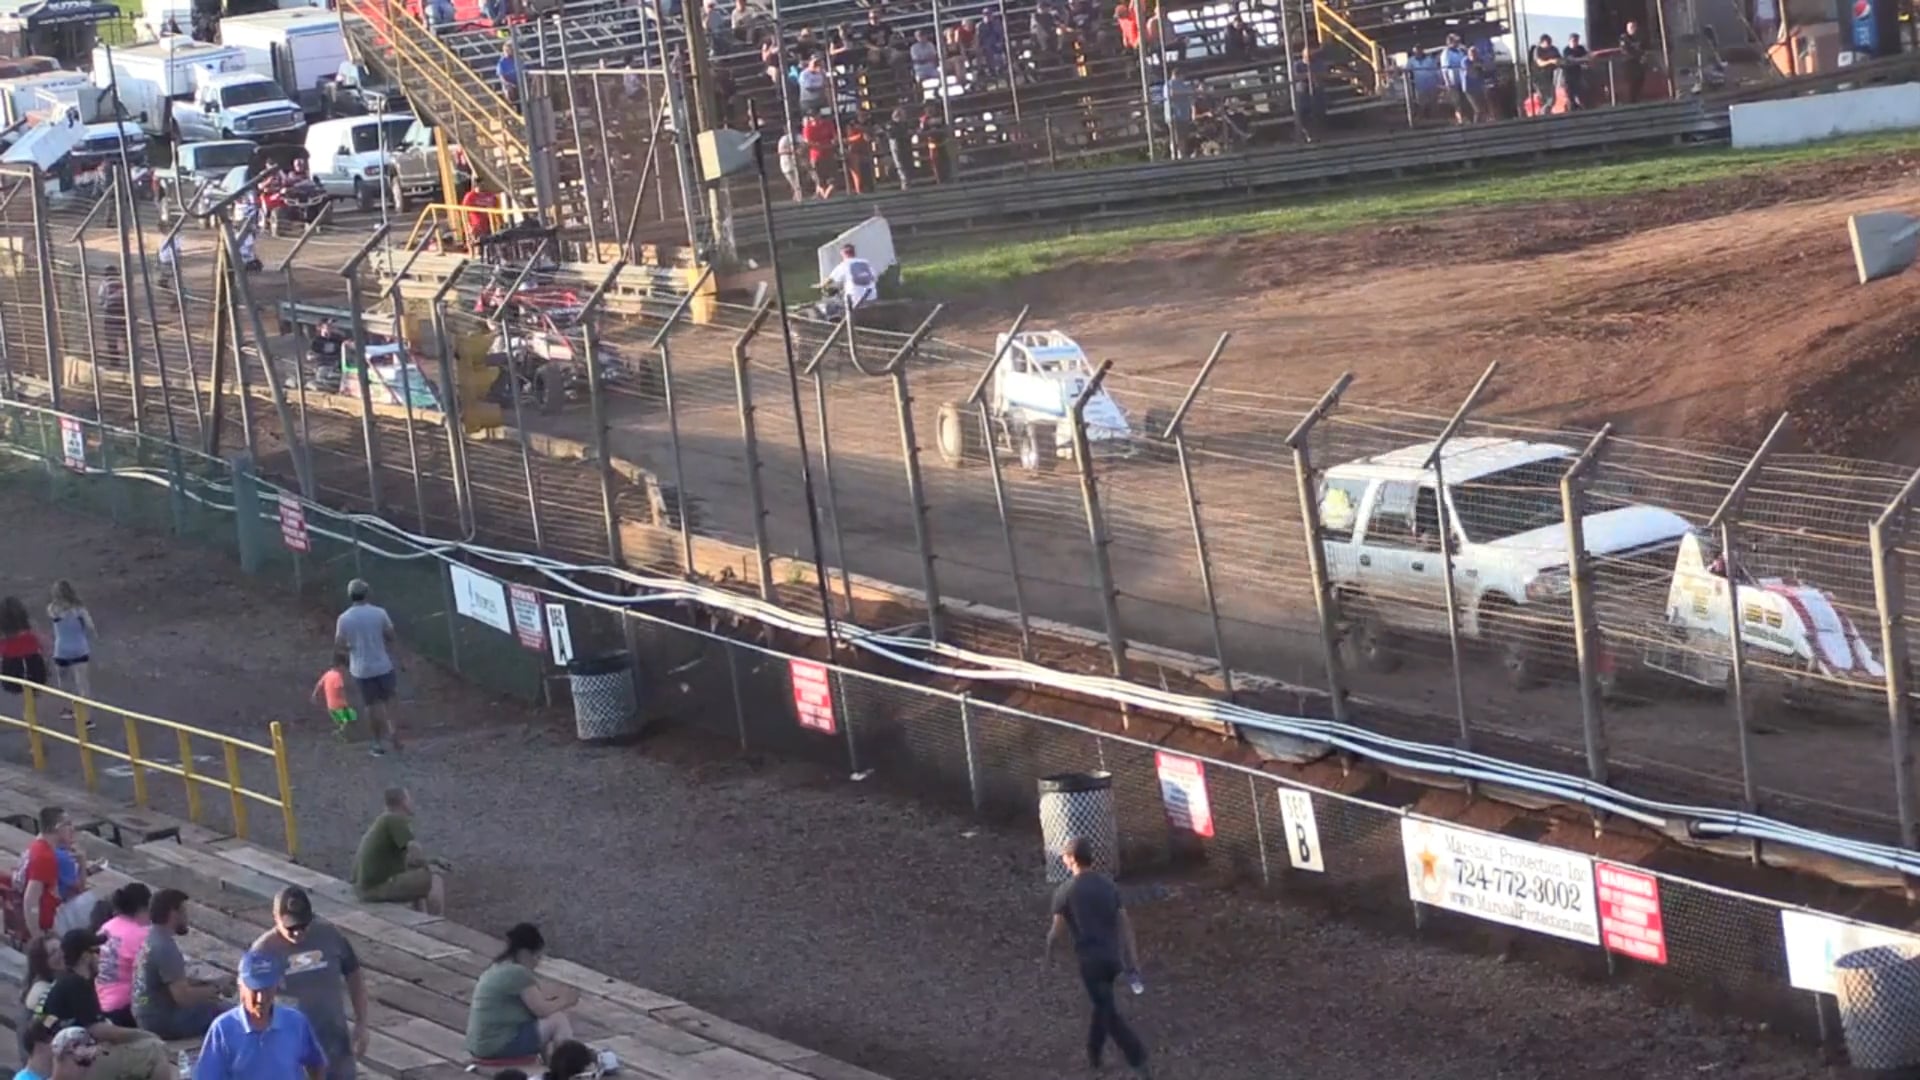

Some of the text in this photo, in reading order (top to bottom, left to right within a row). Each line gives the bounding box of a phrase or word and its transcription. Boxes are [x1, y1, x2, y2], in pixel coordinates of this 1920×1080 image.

[1295, 821, 1311, 863] B
[1499, 845, 1563, 877] Protection
[1453, 857, 1582, 913] 724-772-3002
